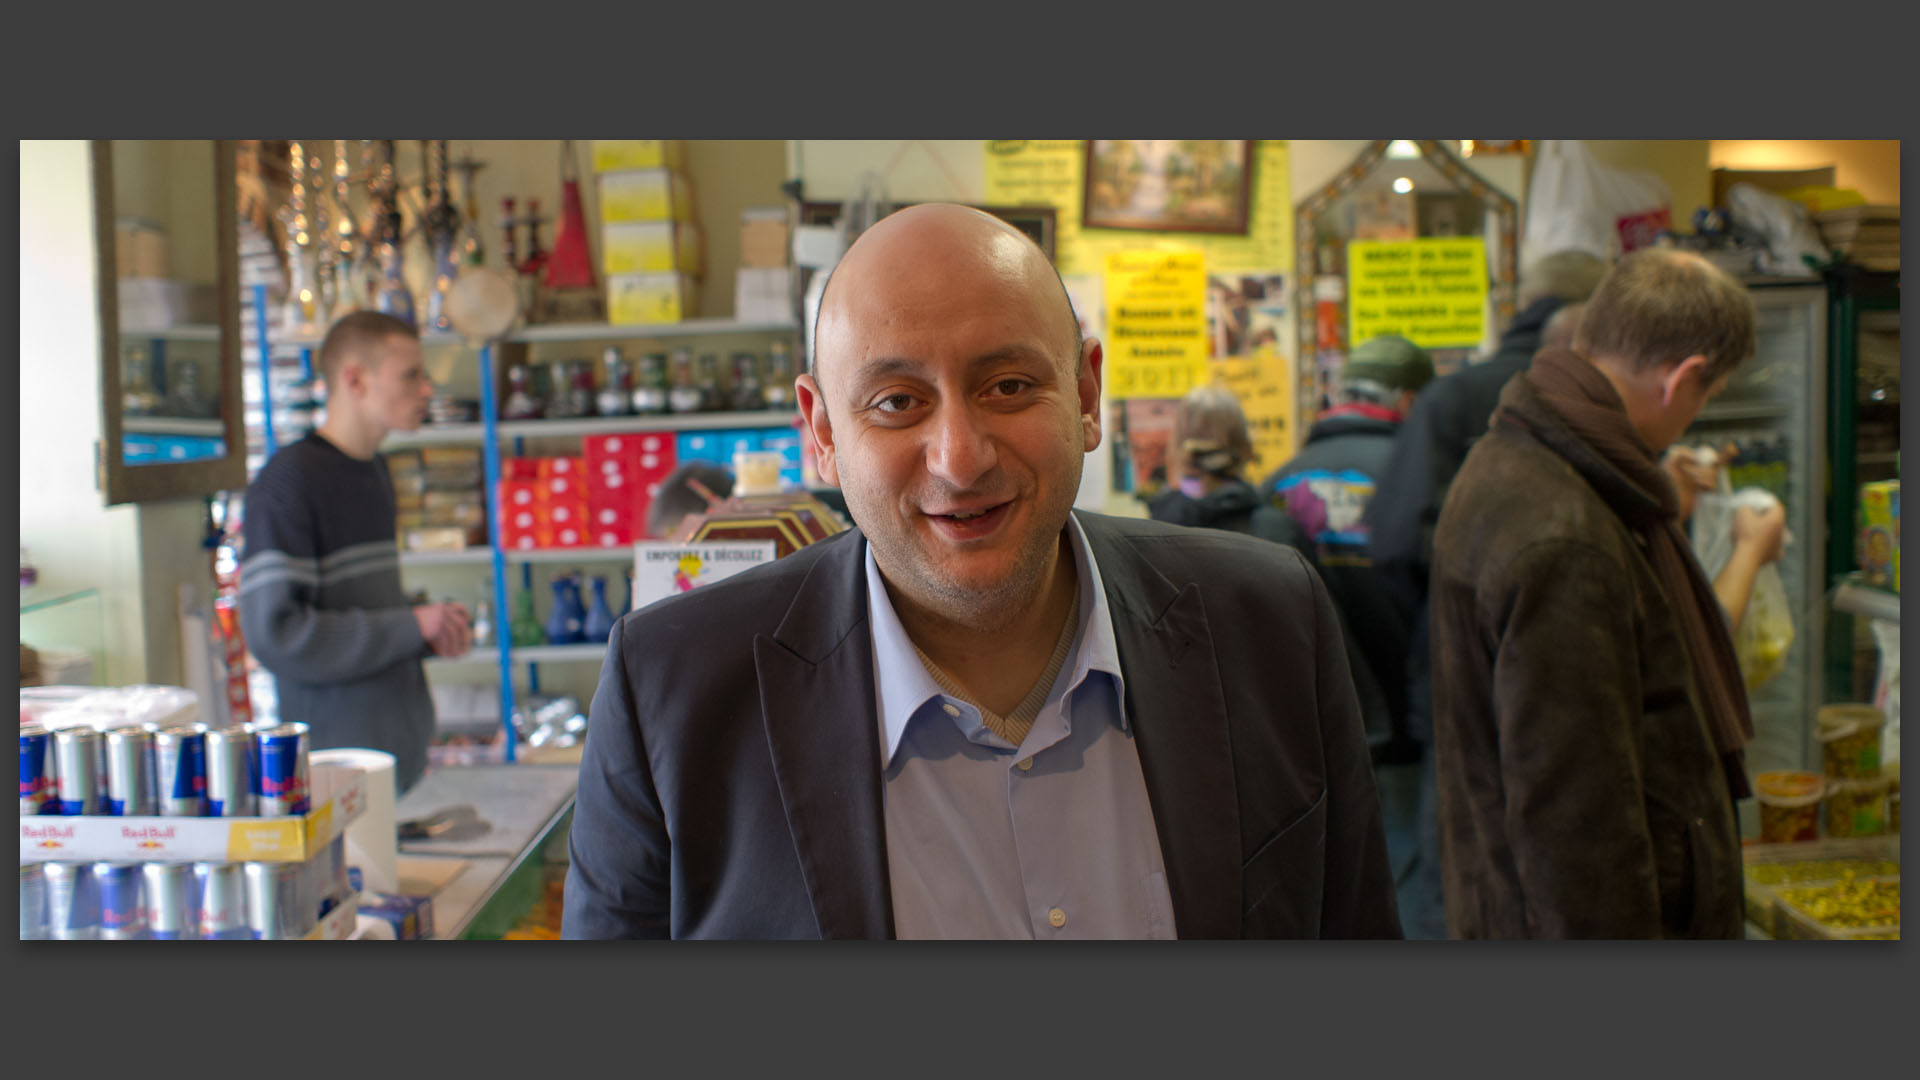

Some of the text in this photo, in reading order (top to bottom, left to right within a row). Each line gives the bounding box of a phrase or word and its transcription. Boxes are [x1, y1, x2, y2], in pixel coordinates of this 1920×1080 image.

[1365, 250, 1411, 261] MERCI
[1116, 307, 1197, 319] Bonne et
[1113, 326, 1199, 338] Heureuse
[1128, 346, 1185, 358] Année
[714, 549, 763, 561] DÉCOLLEZ
[22, 825, 74, 838] Red Bull
[122, 825, 175, 838] Red Bull
